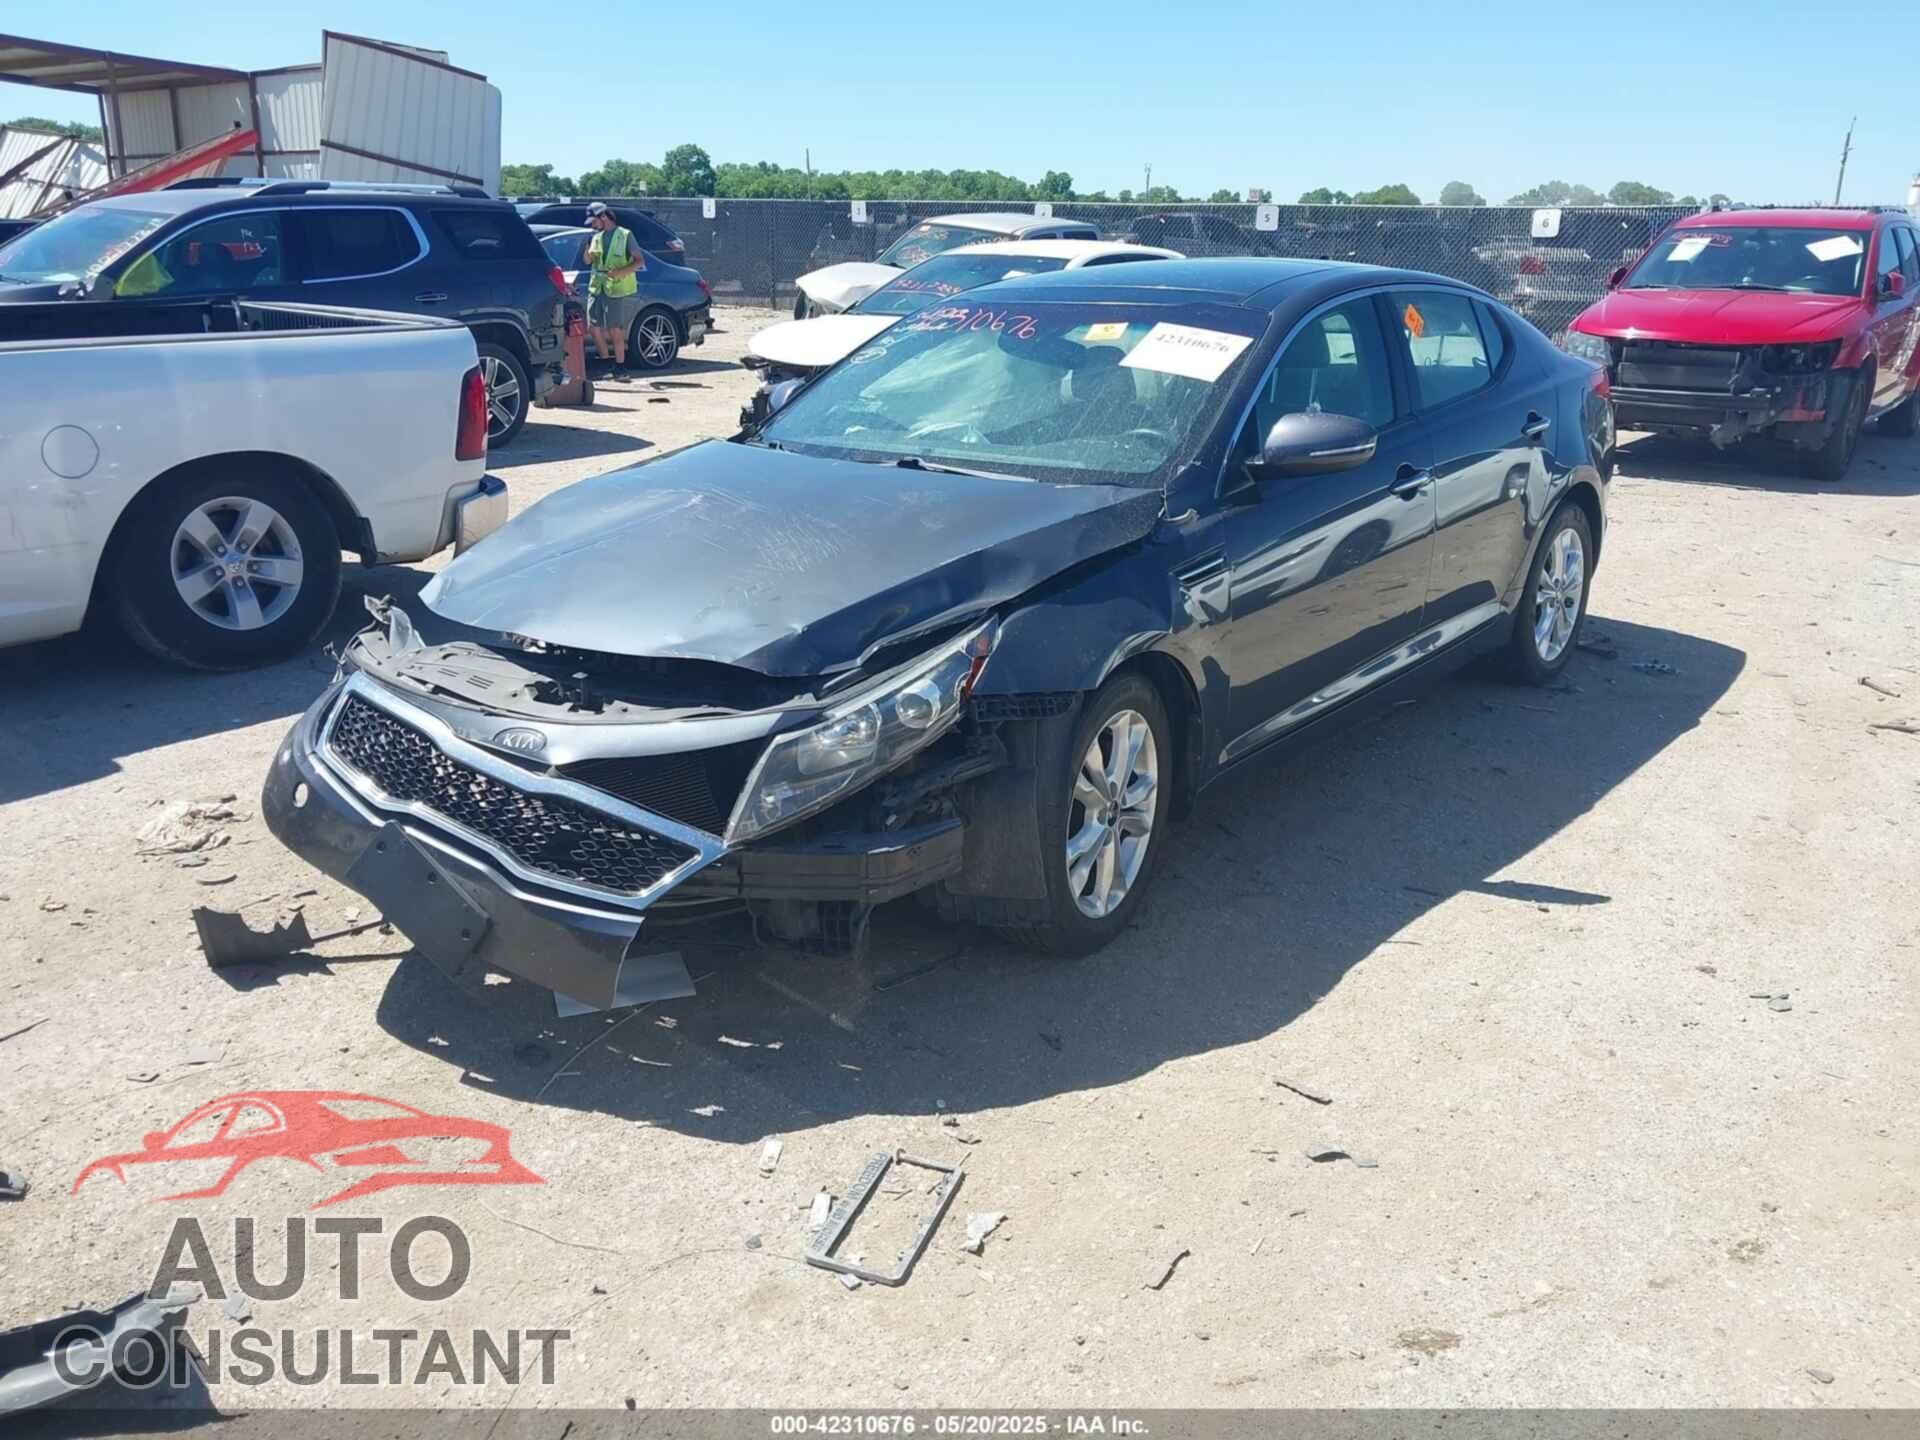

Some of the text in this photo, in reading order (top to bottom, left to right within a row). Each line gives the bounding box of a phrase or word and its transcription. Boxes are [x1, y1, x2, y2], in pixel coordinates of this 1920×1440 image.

[1263, 213, 1272, 223] 5
[1542, 217, 1551, 228] 6
[502, 733, 535, 750] KIA
